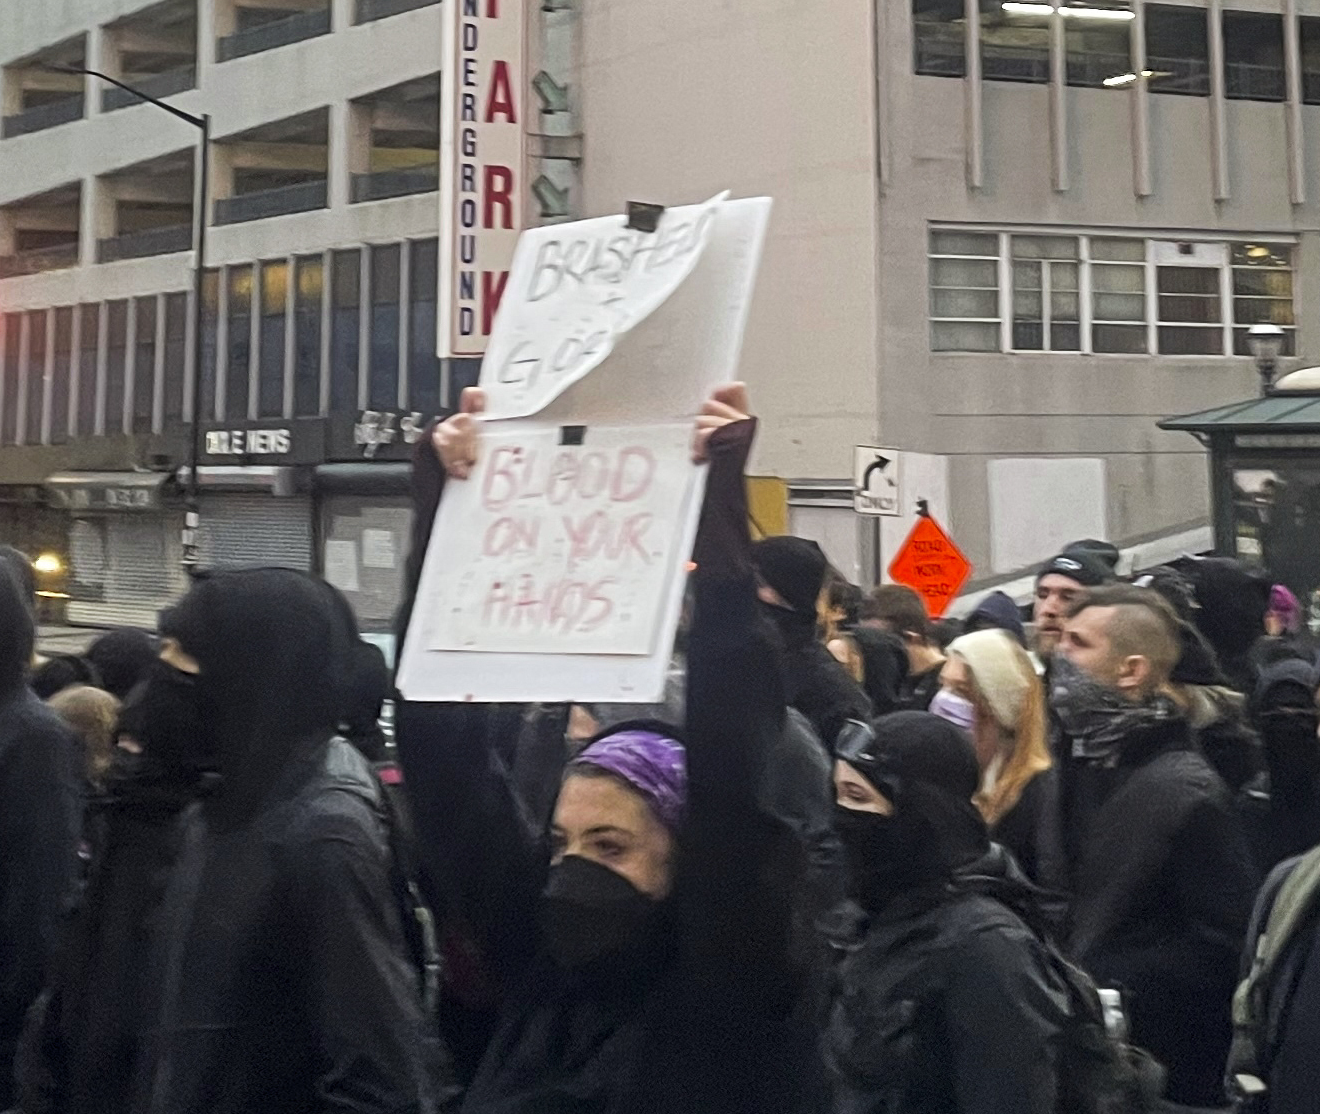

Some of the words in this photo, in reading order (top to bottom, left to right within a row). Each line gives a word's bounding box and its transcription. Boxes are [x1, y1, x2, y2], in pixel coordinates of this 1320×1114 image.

[481, 445, 657, 511] BLOOD
[482, 517, 541, 558] ON
[561, 510, 655, 566] YOUR
[482, 575, 617, 635] HANDS
